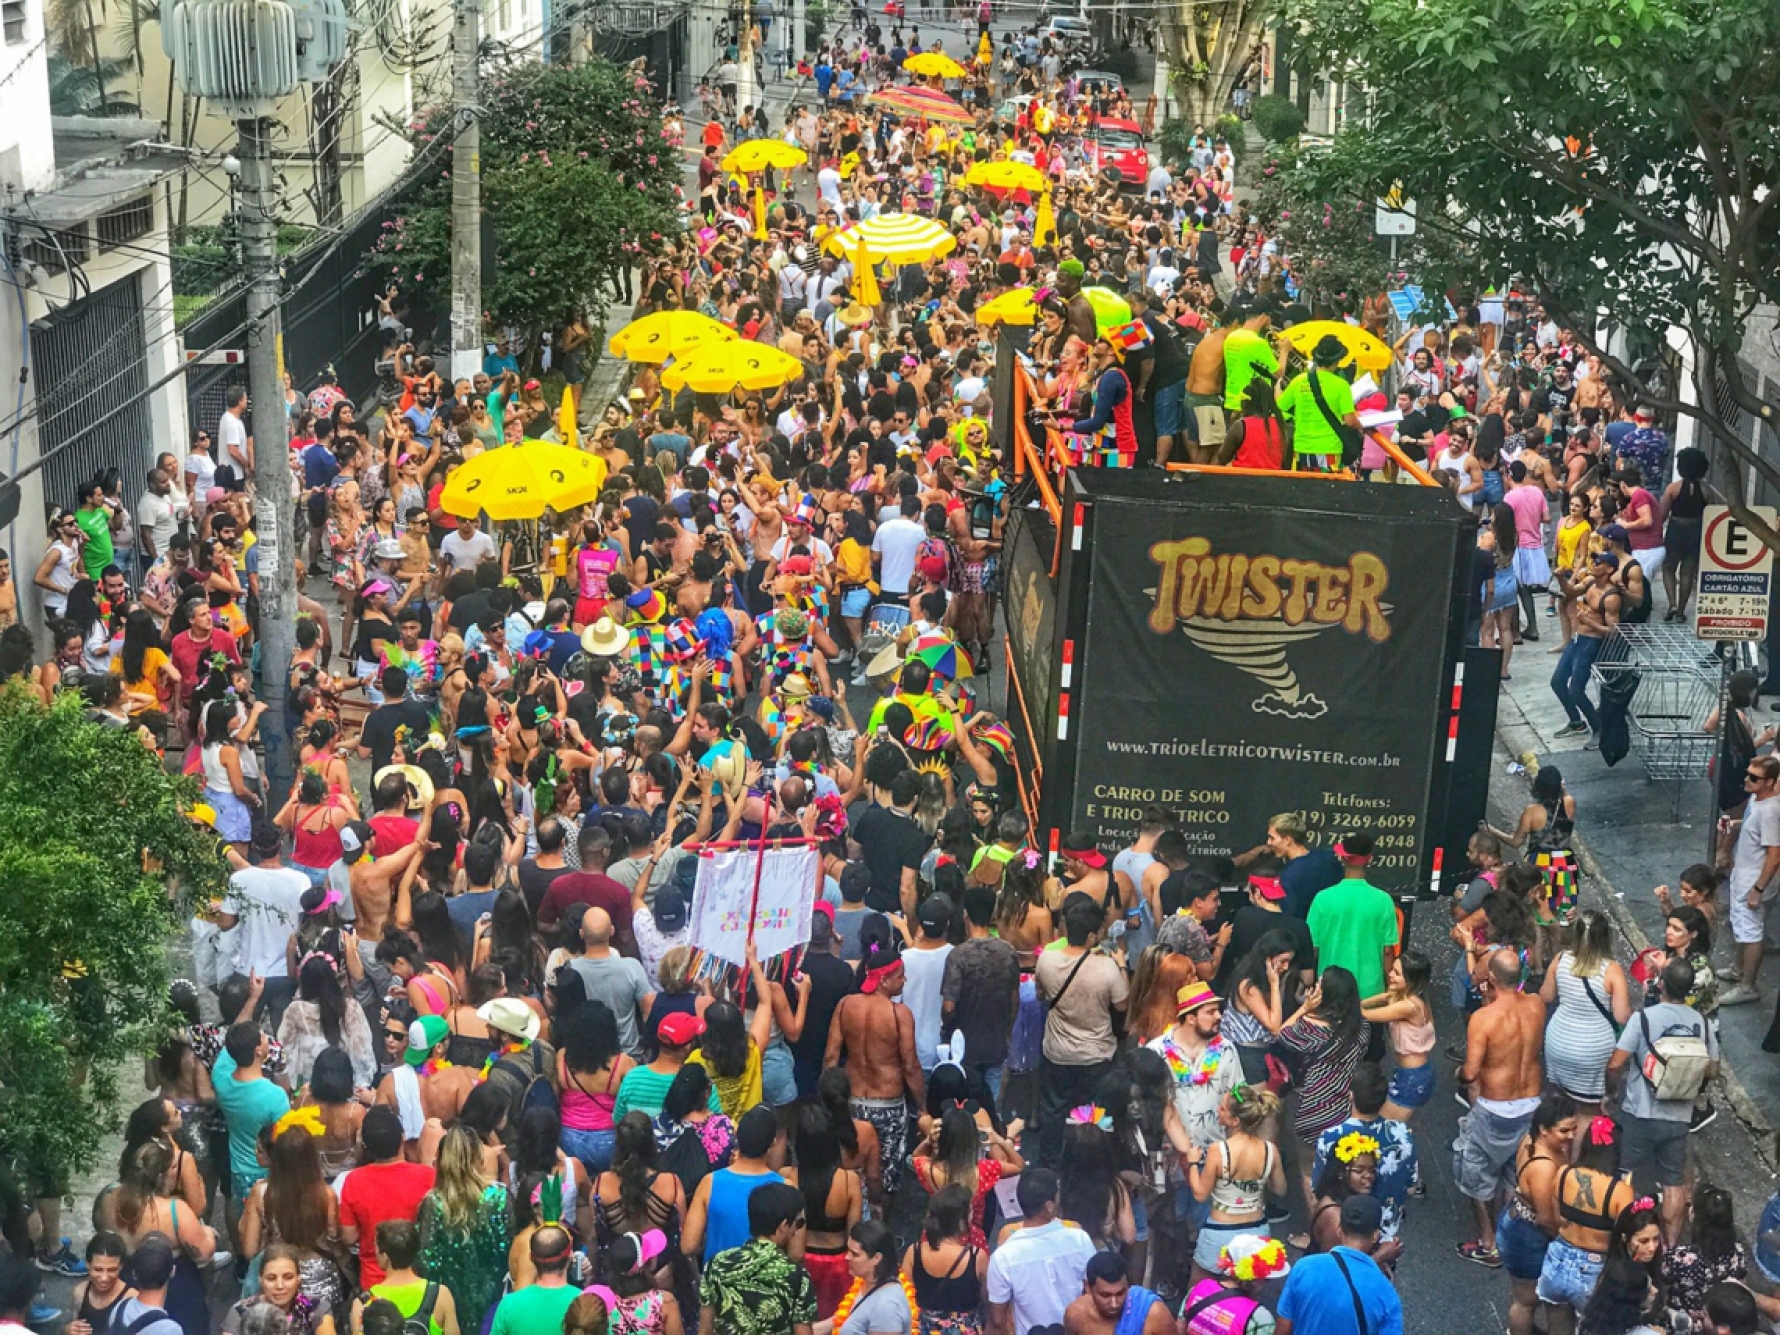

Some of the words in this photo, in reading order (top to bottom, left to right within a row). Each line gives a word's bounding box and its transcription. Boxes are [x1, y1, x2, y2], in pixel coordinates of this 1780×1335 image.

[1725, 519, 1748, 555] E
[1704, 574, 1765, 583] OBRIGATÓRIO
[1147, 536, 1393, 643] TWISTER
[1704, 583, 1739, 592] CARTÃO
[1741, 585, 1764, 593] AZUL
[1697, 606, 1733, 616] Sábado
[1710, 619, 1752, 627] PROIBIDO
[1094, 784, 1156, 802] CARRO
[1161, 789, 1184, 802] DE
[1189, 790, 1226, 803] SOM
[1086, 803, 1096, 818] E
[1102, 805, 1143, 821] TRIO
[1171, 806, 1230, 824] TRICO
[1332, 812, 1416, 828] 3269-6059
